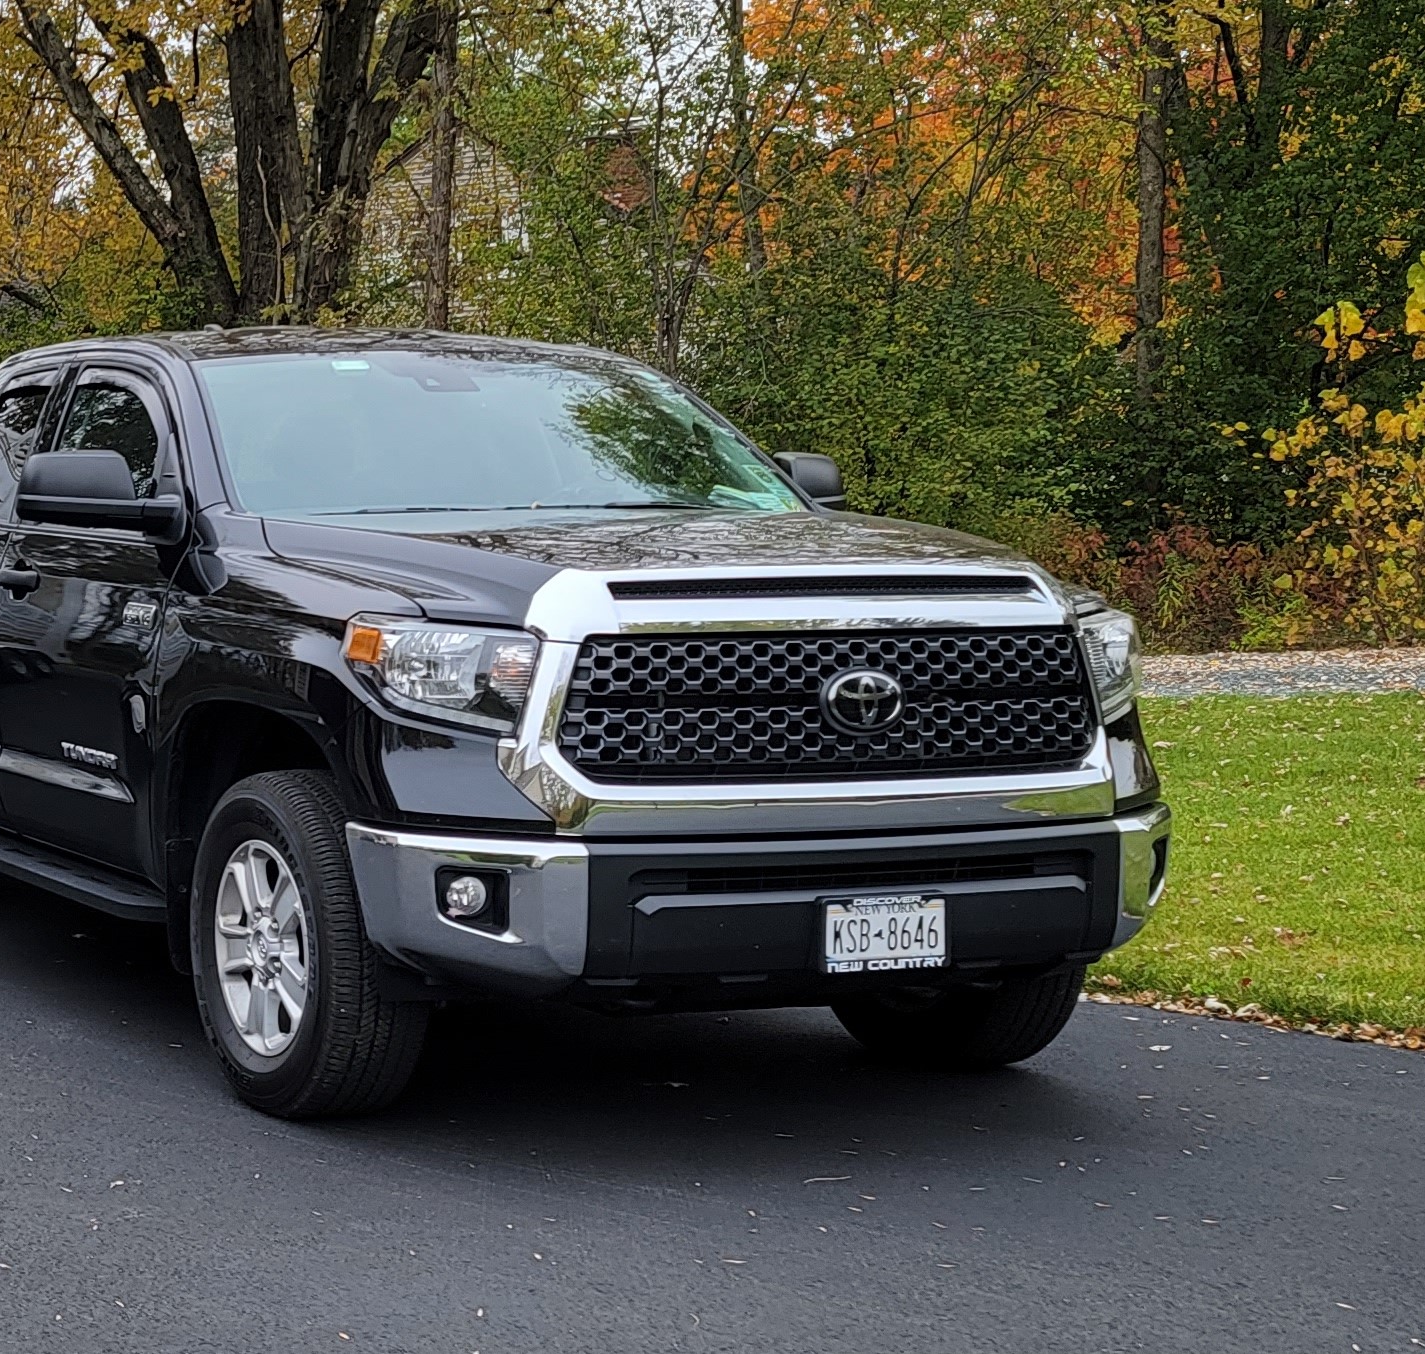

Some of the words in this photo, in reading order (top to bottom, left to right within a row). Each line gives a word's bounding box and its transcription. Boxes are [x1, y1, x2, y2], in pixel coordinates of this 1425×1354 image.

[61, 742, 118, 769] TUNDRA
[853, 896, 921, 906] DISCOVER
[855, 905, 882, 915] NEW
[885, 904, 916, 914] YORK
[833, 919, 870, 954] KSB
[888, 915, 938, 950] 8646
[827, 961, 863, 973] NEW
[867, 957, 945, 971] COUNTRY
